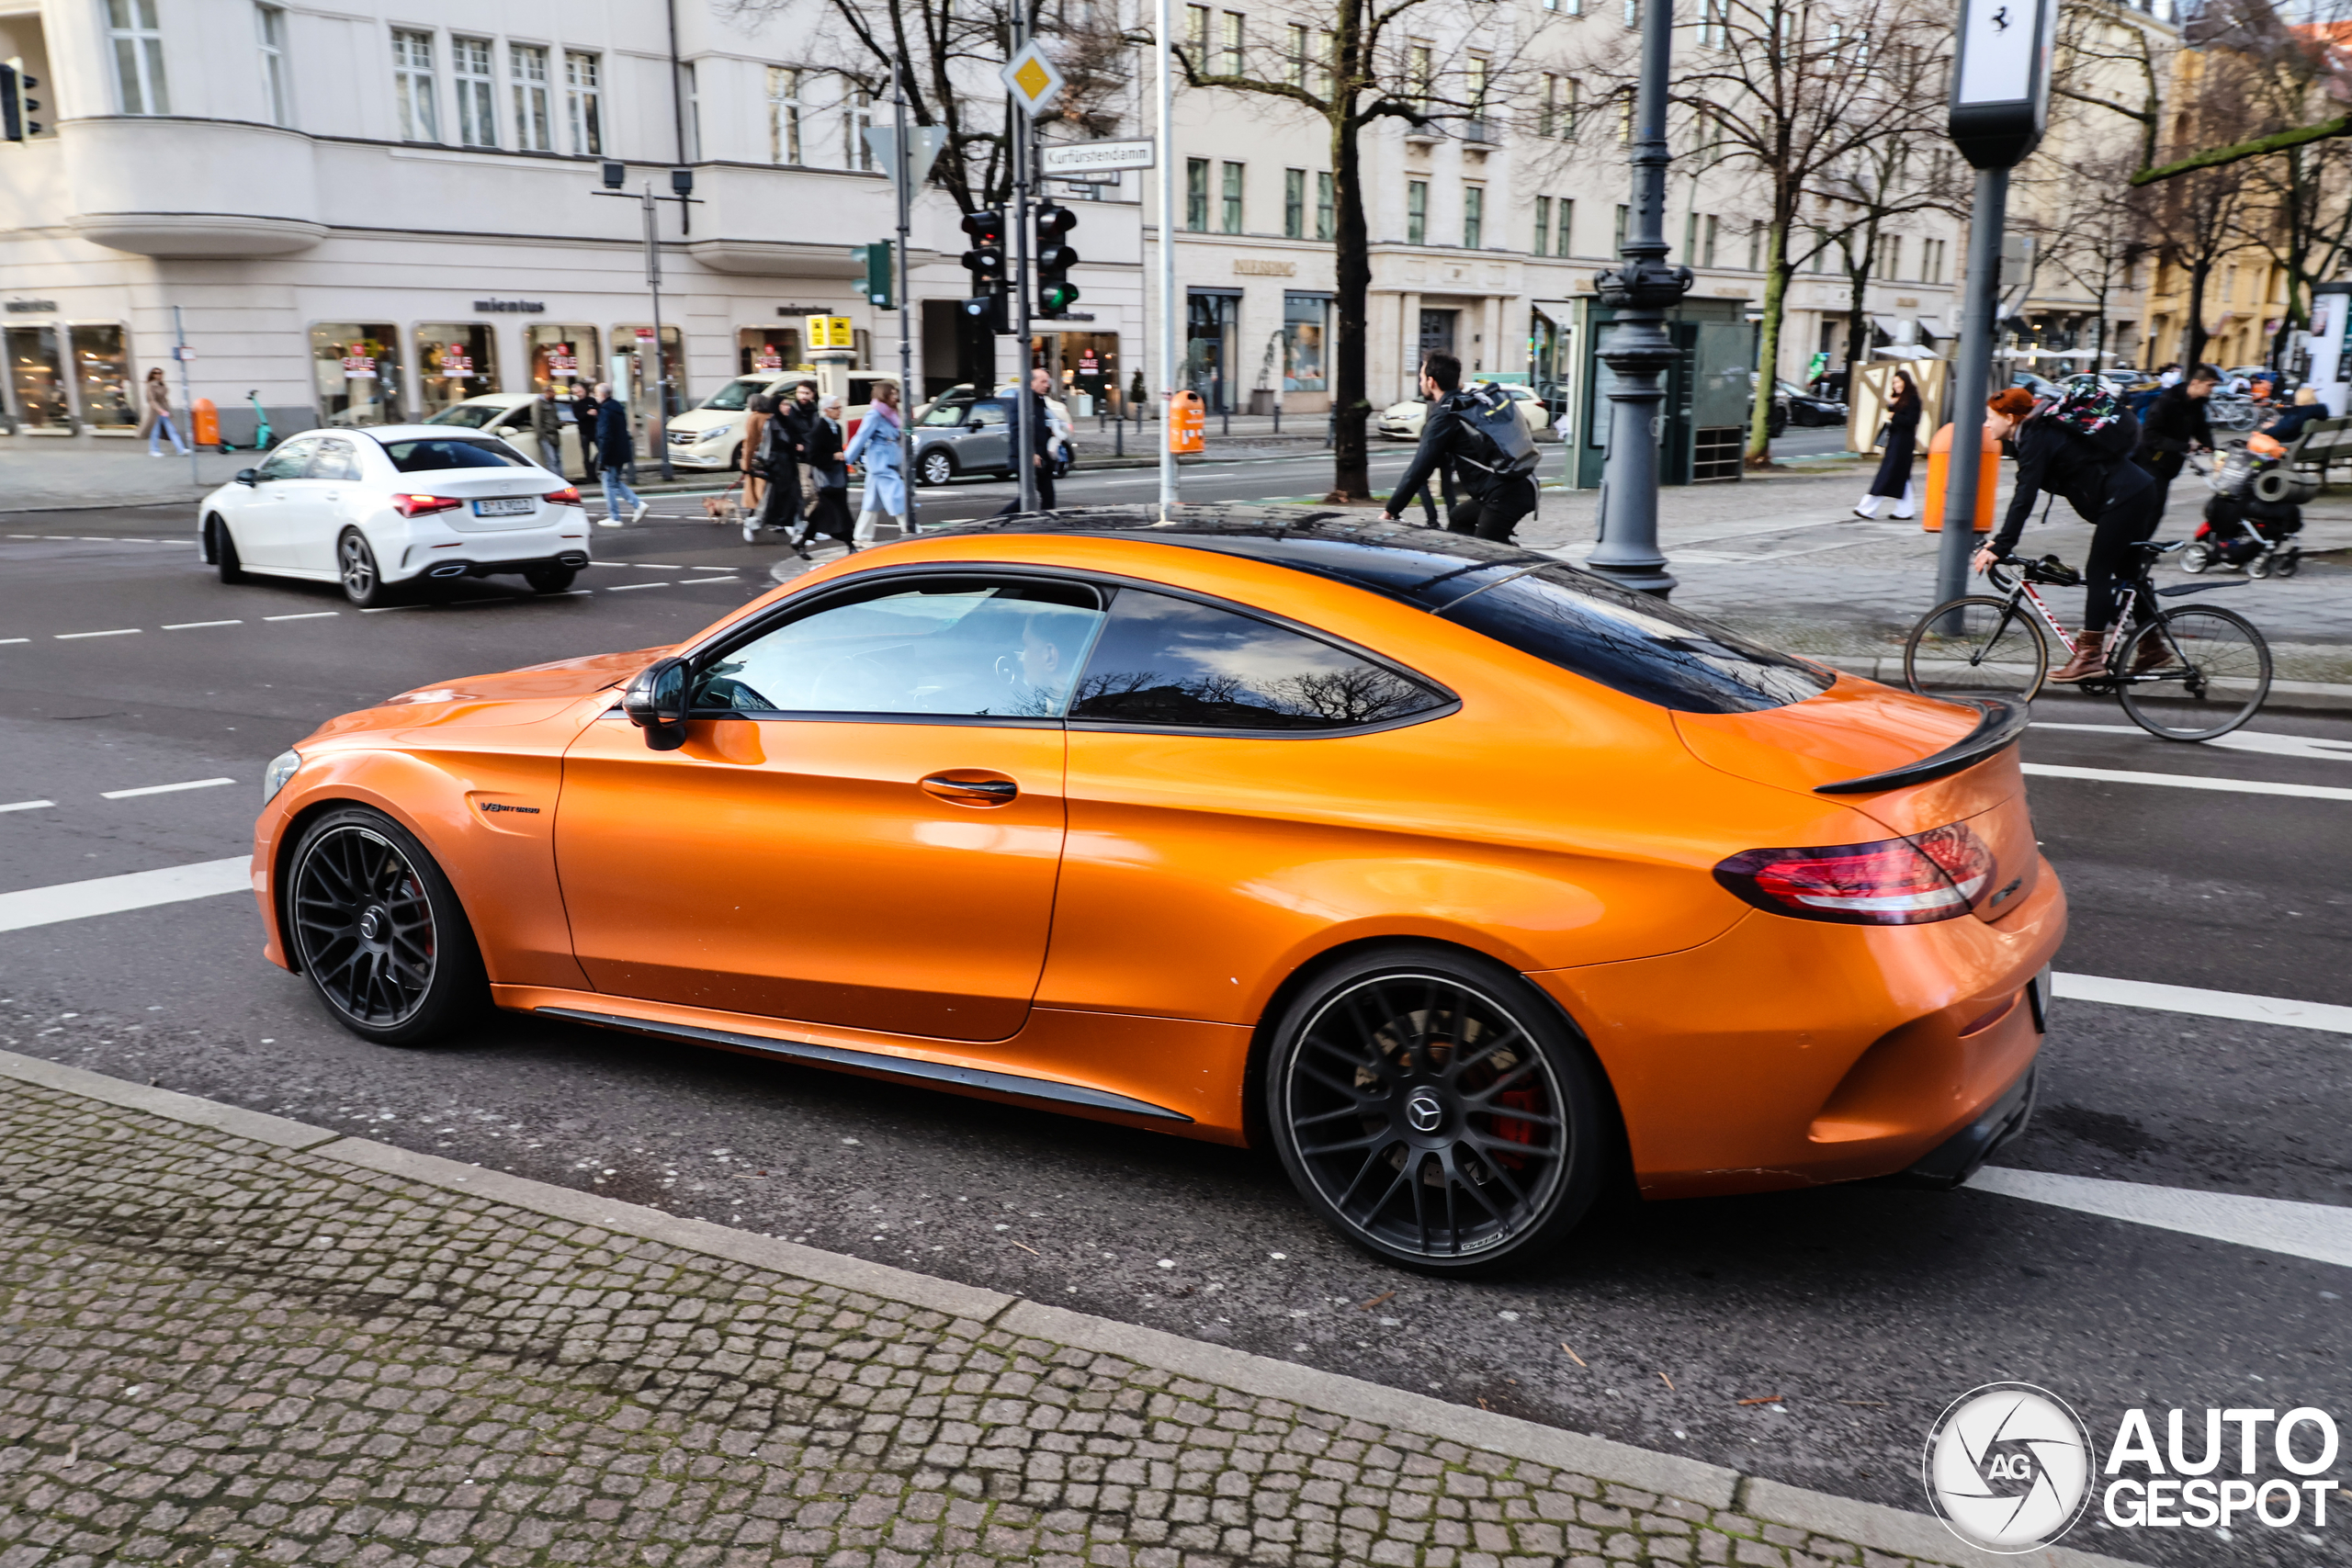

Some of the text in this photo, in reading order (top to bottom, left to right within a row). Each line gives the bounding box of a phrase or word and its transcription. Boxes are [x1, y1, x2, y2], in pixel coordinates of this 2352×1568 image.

[1046, 147, 1149, 164] Kurfürstendamm
[473, 297, 545, 312] mientus
[342, 356, 376, 370] SALE
[441, 356, 473, 368] SALE
[548, 356, 578, 368] SALE
